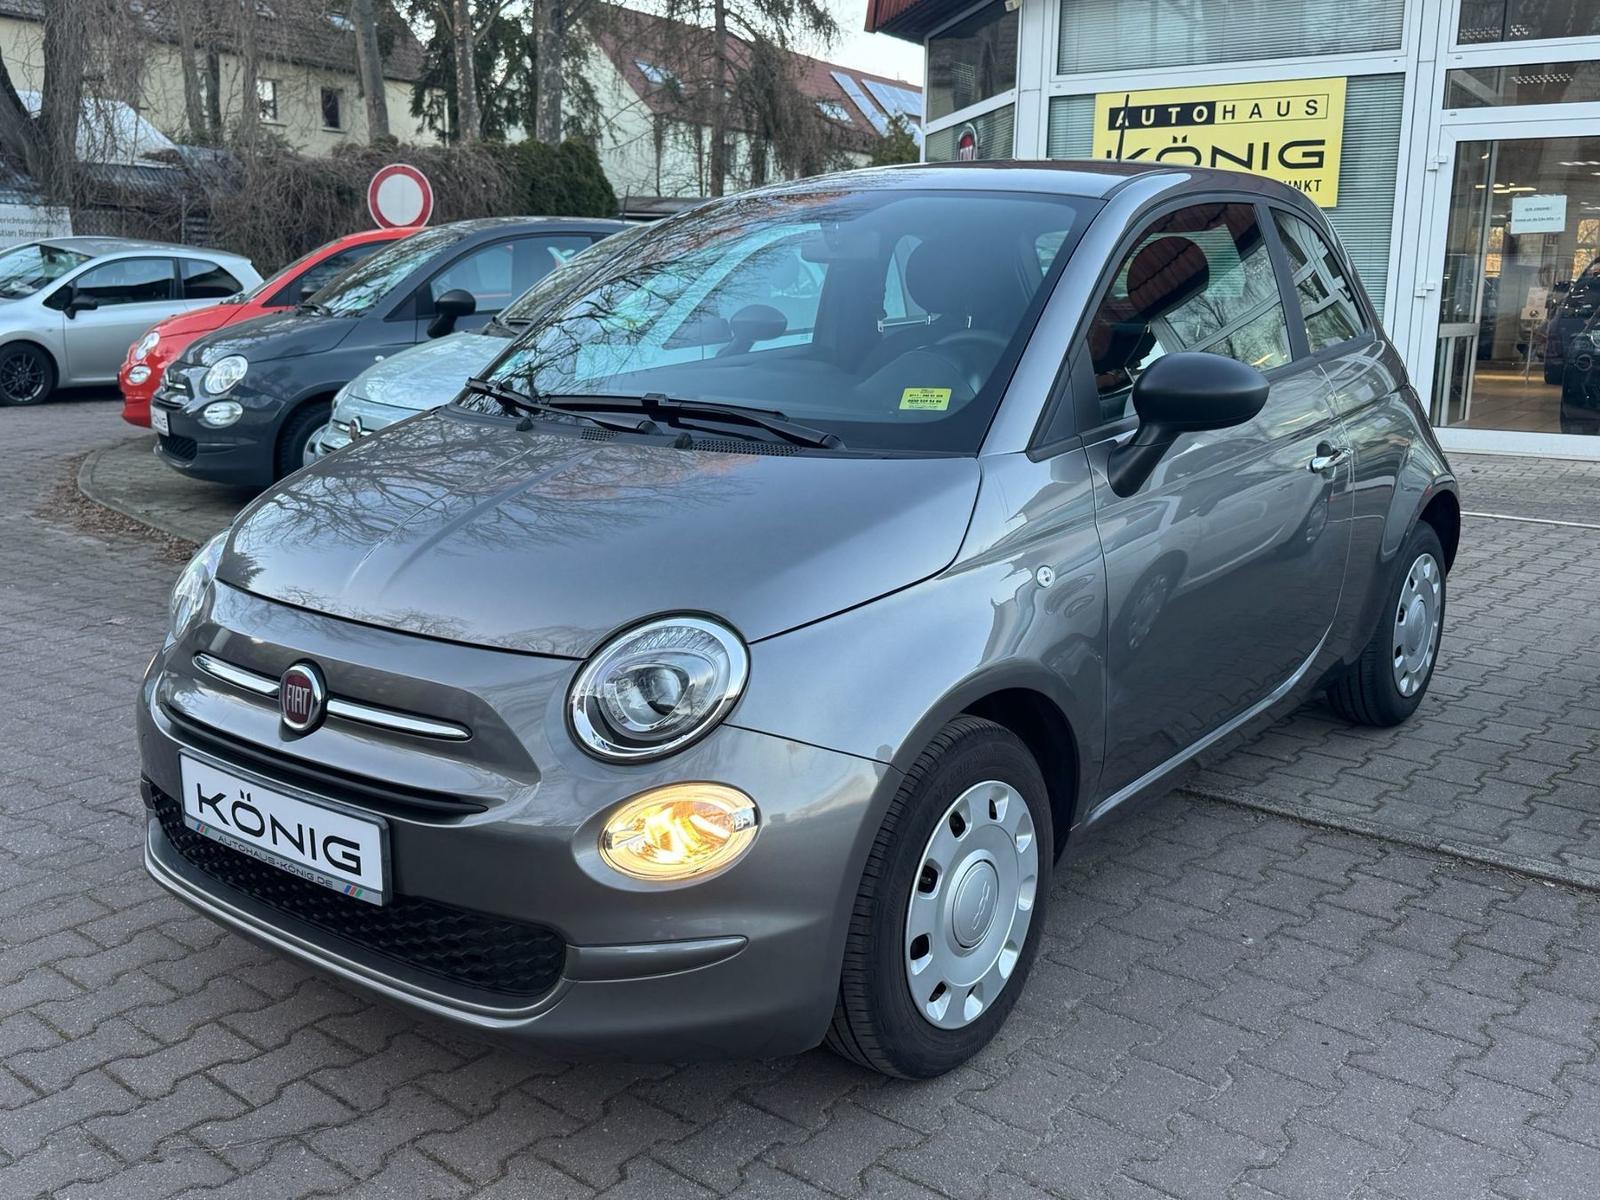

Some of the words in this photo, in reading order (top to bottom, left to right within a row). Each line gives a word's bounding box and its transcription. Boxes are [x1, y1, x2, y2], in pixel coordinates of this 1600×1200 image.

[1115, 99, 1319, 127] AUTOHAUS
[286, 683, 312, 716] FIAT
[196, 783, 362, 877] KÖNIG
